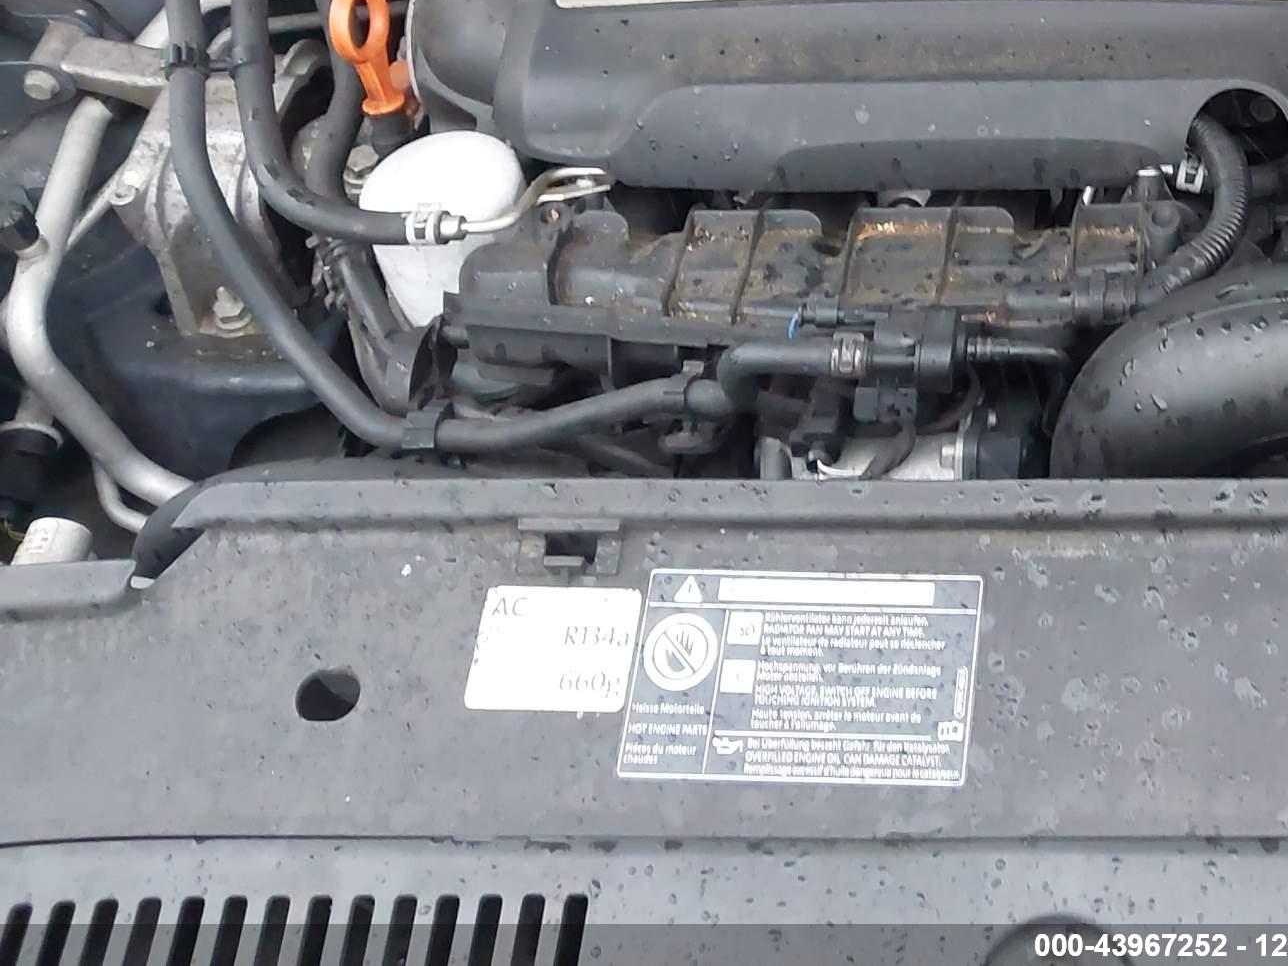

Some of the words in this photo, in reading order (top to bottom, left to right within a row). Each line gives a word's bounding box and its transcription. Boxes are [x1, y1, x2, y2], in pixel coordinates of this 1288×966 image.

[491, 596, 528, 617] AC
[763, 622, 805, 635] RADIATOR
[806, 623, 823, 636] FAN
[824, 624, 845, 636] MAY
[845, 625, 870, 637] START
[870, 625, 881, 637] AT
[883, 625, 902, 638] ANY
[755, 684, 778, 696] HIGH
[871, 687, 904, 699] ENGINE
[905, 687, 937, 700] BEFORE
[628, 721, 648, 734] HOT
[648, 722, 681, 735] ENGINE
[682, 723, 708, 736] PARTS
[652, 742, 664, 755] du
[665, 743, 697, 756] moteur
[622, 753, 658, 765] chaudes
[745, 750, 793, 763] OVERFILLED
[793, 751, 826, 764] ENGINE
[843, 753, 862, 766] CAN
[863, 754, 900, 767] DAMAGE
